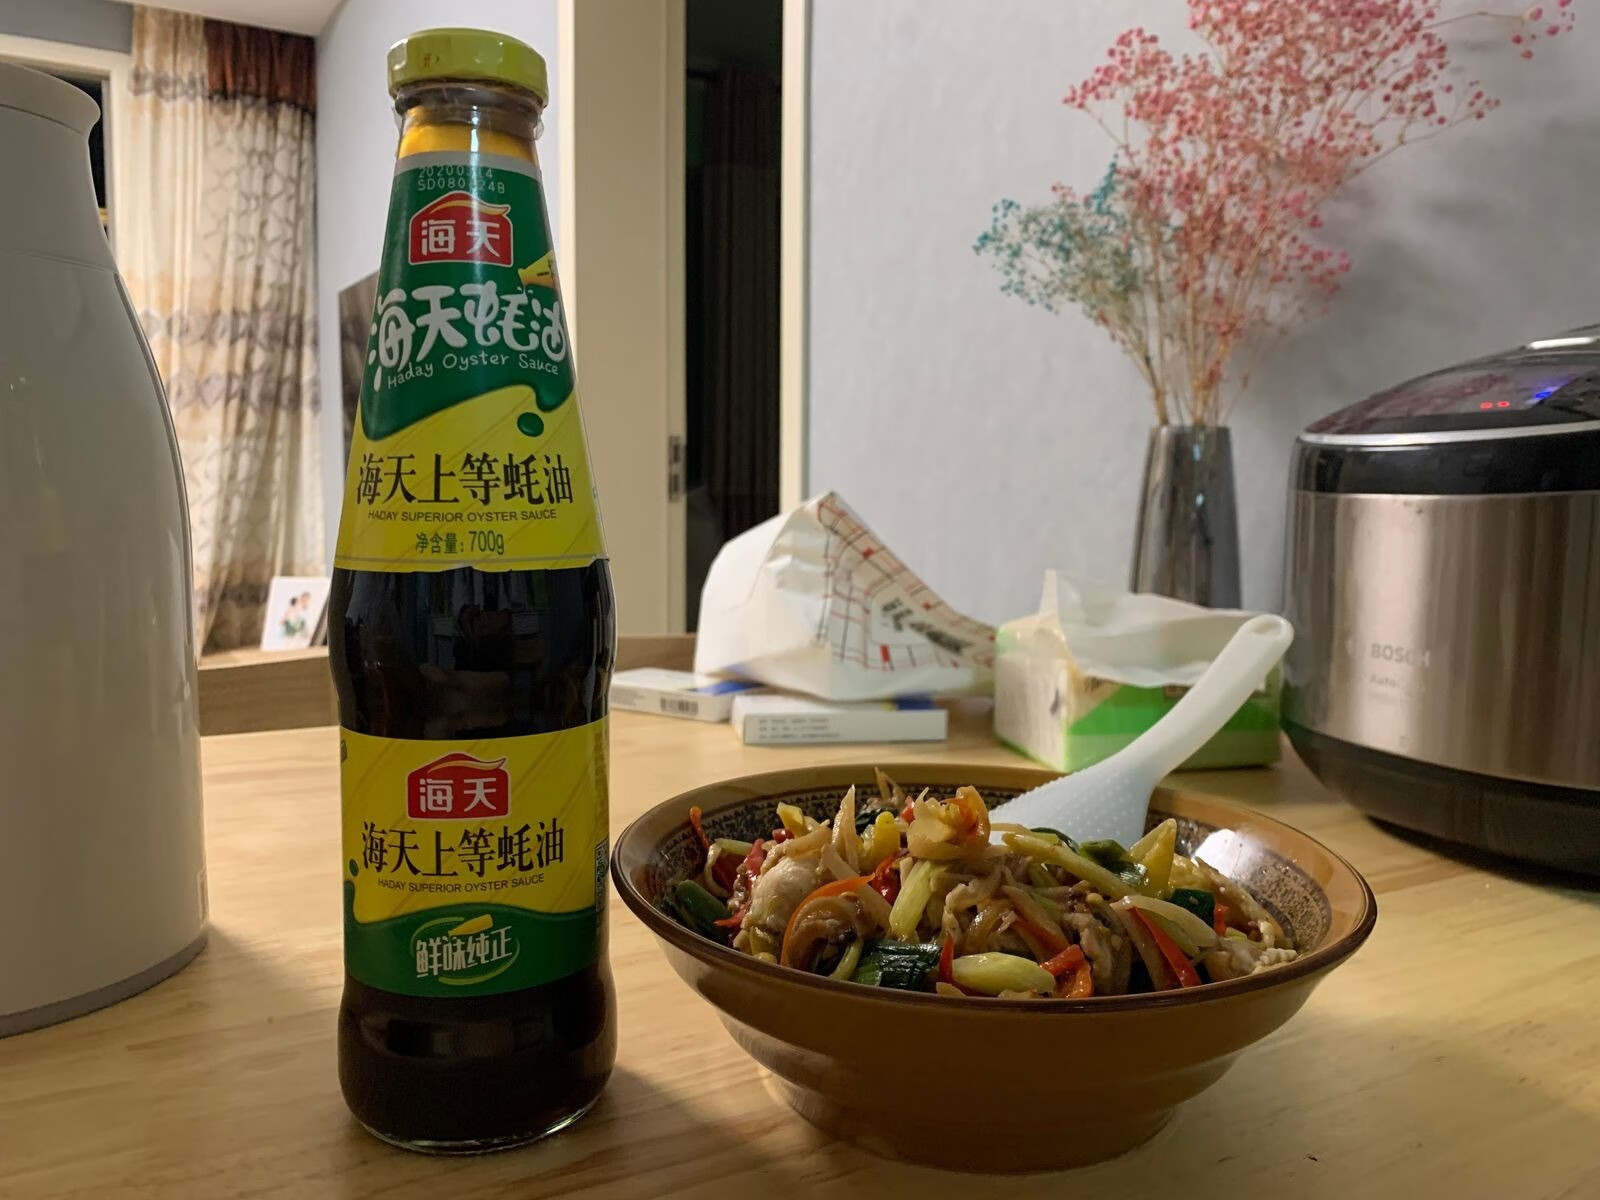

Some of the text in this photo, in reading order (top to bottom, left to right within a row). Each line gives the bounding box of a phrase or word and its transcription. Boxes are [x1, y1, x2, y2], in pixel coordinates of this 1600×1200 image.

[421, 219, 500, 258] 海天
[368, 281, 567, 391] 海天蚝油
[387, 350, 559, 389] Haday Oyster Sauce
[356, 452, 574, 505] 海天上等蚝油
[367, 508, 557, 522] HADAY SUPERIOR OYSTER SAUCE
[419, 777, 497, 813] 海天
[361, 817, 565, 878] 海天上等蚝油
[377, 873, 545, 893] HADAY SUPERIOR OYSTER SAUCE
[415, 925, 514, 978] 鲜味纯正
